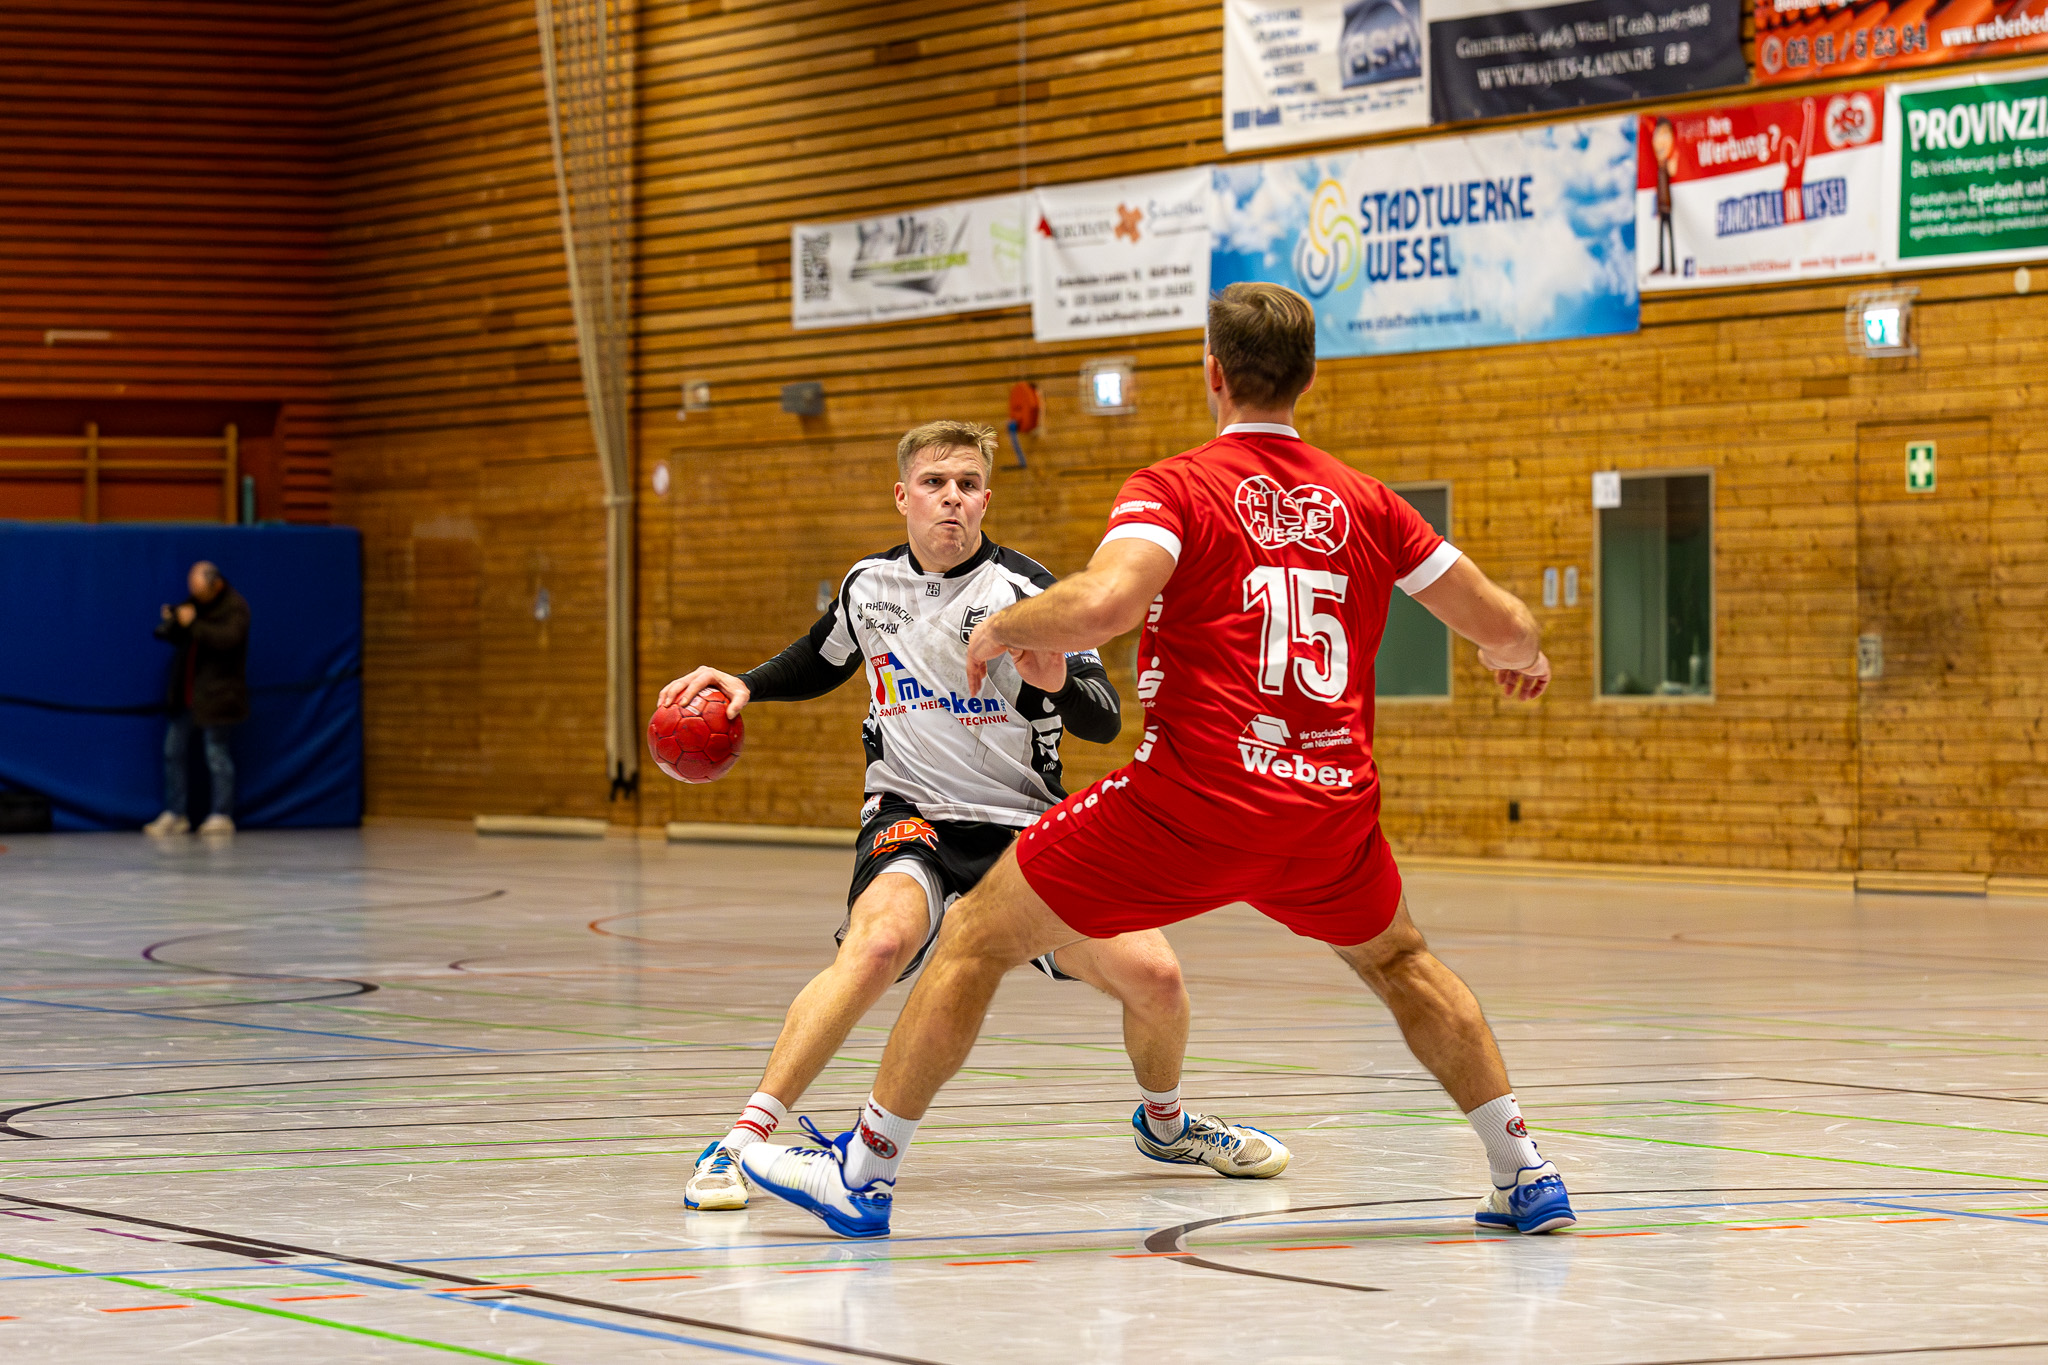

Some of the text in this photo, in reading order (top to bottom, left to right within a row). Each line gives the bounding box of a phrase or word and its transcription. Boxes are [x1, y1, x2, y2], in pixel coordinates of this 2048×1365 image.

[1786, 37, 1810, 67] 02
[1854, 29, 1868, 59] 5
[1873, 26, 1898, 58] 23
[1902, 22, 1928, 53] 94
[1697, 124, 1781, 167] Werbung?
[1908, 95, 2048, 152] PROVINZI
[1360, 174, 1536, 235] STADTWERKE
[1366, 234, 1459, 282] WESEL
[1248, 489, 1334, 536] HSG
[865, 601, 915, 626] RHEINWACHT
[1242, 564, 1349, 704] 15
[1237, 743, 1354, 788] Weber
